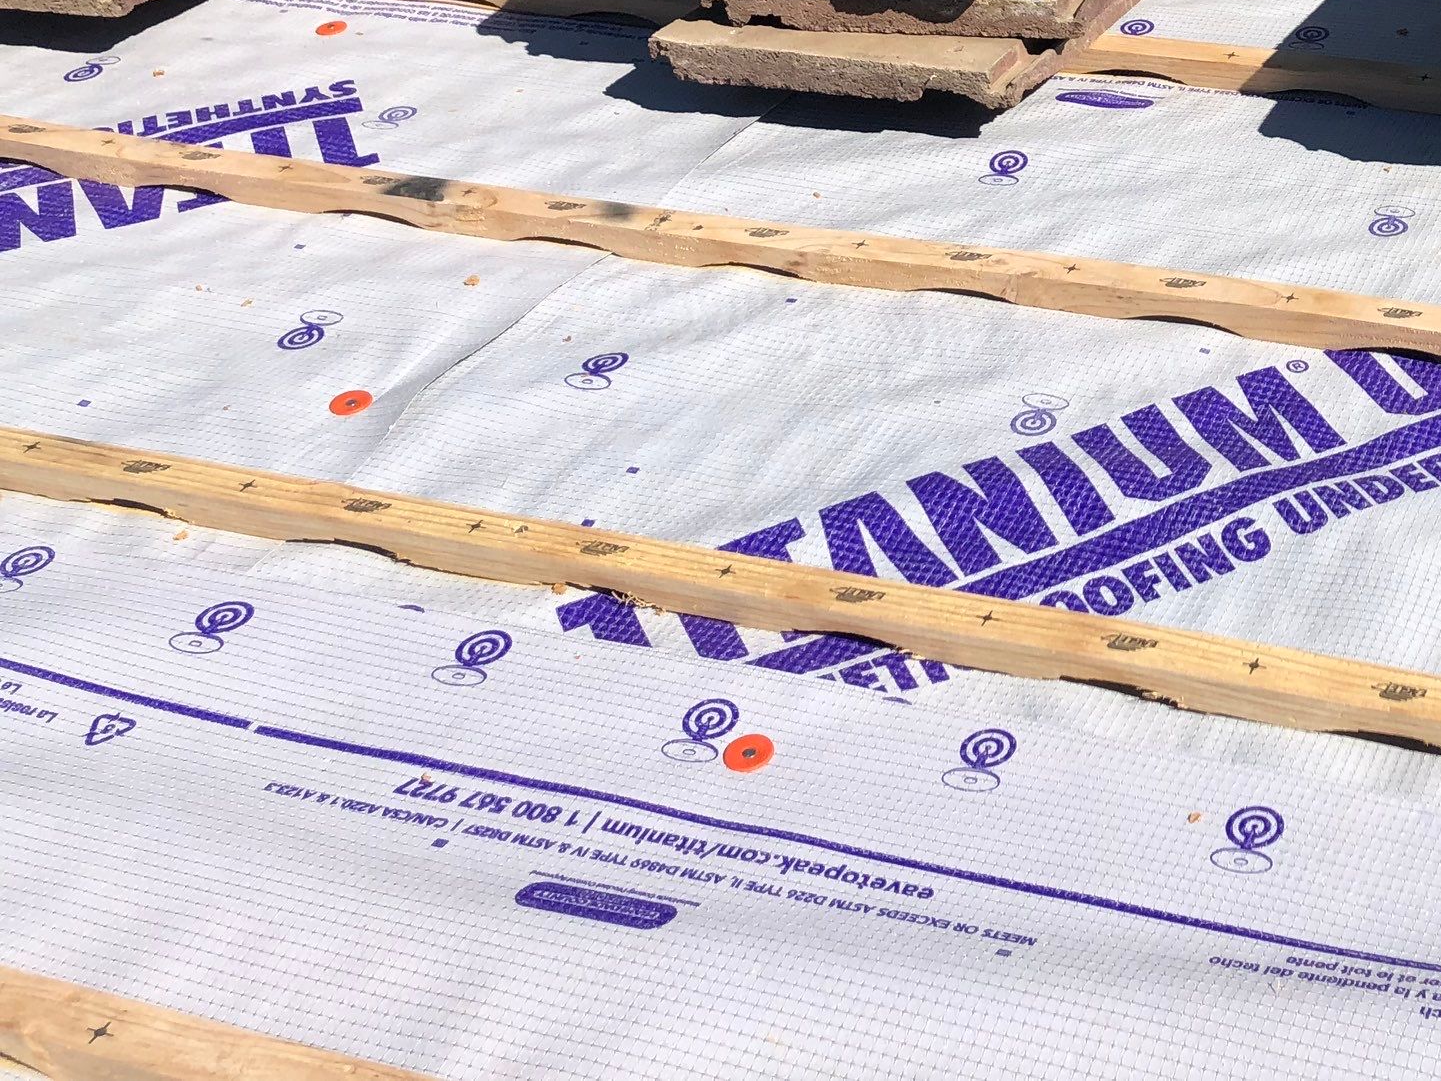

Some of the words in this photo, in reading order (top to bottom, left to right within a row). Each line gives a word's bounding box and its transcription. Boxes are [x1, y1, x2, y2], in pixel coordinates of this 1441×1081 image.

[1147, 81, 1174, 90] ASTM
[92, 80, 355, 143] SYNTHETI
[1038, 517, 1272, 616] OOFING
[263, 781, 317, 800] A123.3
[316, 792, 331, 803] &
[393, 777, 460, 804] 9727
[329, 795, 381, 817] A220.1
[458, 791, 513, 814] 567
[380, 805, 449, 829] CAN/CSA
[511, 800, 563, 824] 800
[563, 810, 579, 827] 1
[460, 823, 513, 842] D8257
[512, 832, 557, 850] ASTM
[555, 841, 572, 854] &
[569, 845, 590, 859] IV
[586, 849, 629, 867] TYPE
[601, 816, 935, 900] eavetopeak.com/titanium
[628, 857, 680, 877] D4869
[678, 866, 727, 885] ASTM
[743, 881, 784, 898] TYPE
[785, 889, 828, 906] D226
[828, 897, 876, 914] ASTM
[875, 907, 952, 930] EXCEEDS
[952, 921, 980, 935] OR
[981, 928, 1038, 946] MEETS
[1208, 955, 1260, 974] techo
[1263, 965, 1295, 979] del
[1285, 956, 1340, 973] pente
[1340, 965, 1372, 978] toit
[1297, 971, 1391, 994] pendiente
[1394, 986, 1411, 999] la
[1415, 988, 1430, 1001] y
